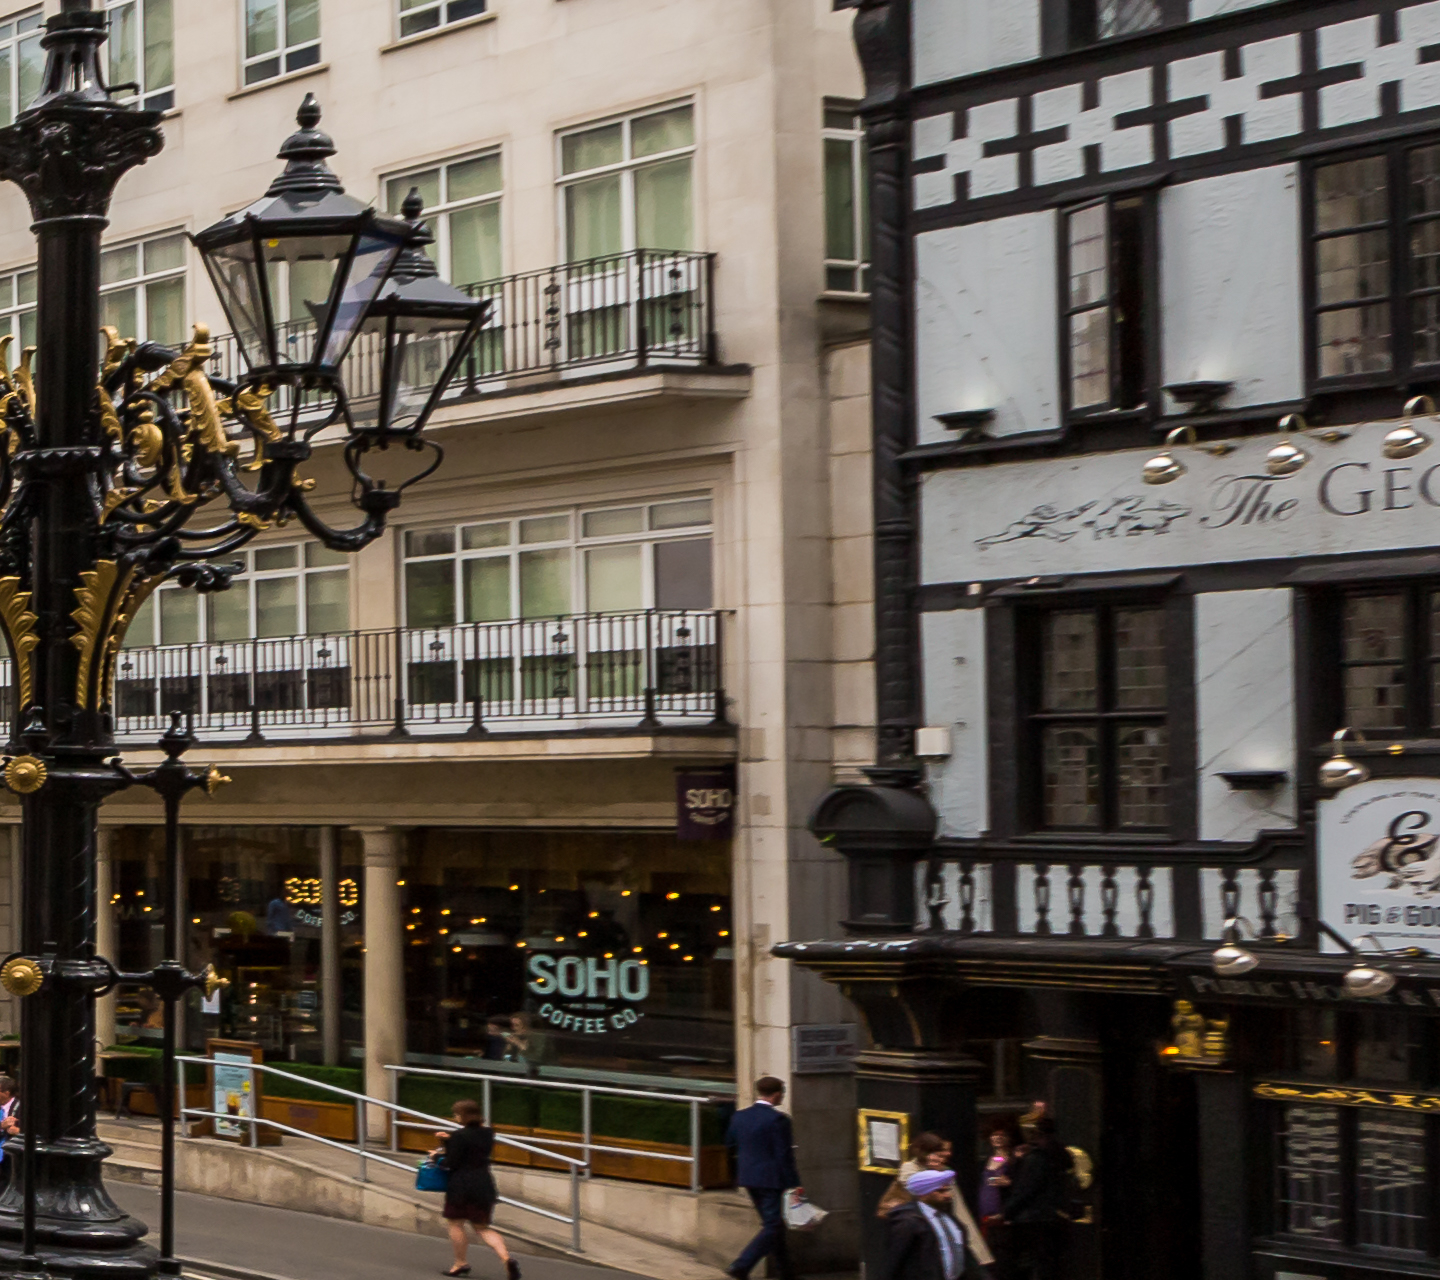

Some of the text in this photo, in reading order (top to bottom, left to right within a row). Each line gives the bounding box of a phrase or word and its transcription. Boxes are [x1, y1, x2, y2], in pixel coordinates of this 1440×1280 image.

[1198, 474, 1299, 529] The
[685, 789, 731, 808] SOHO
[1344, 903, 1382, 925] PIG
[527, 954, 649, 1001] SOHO
[539, 1003, 607, 1033] COFFEE
